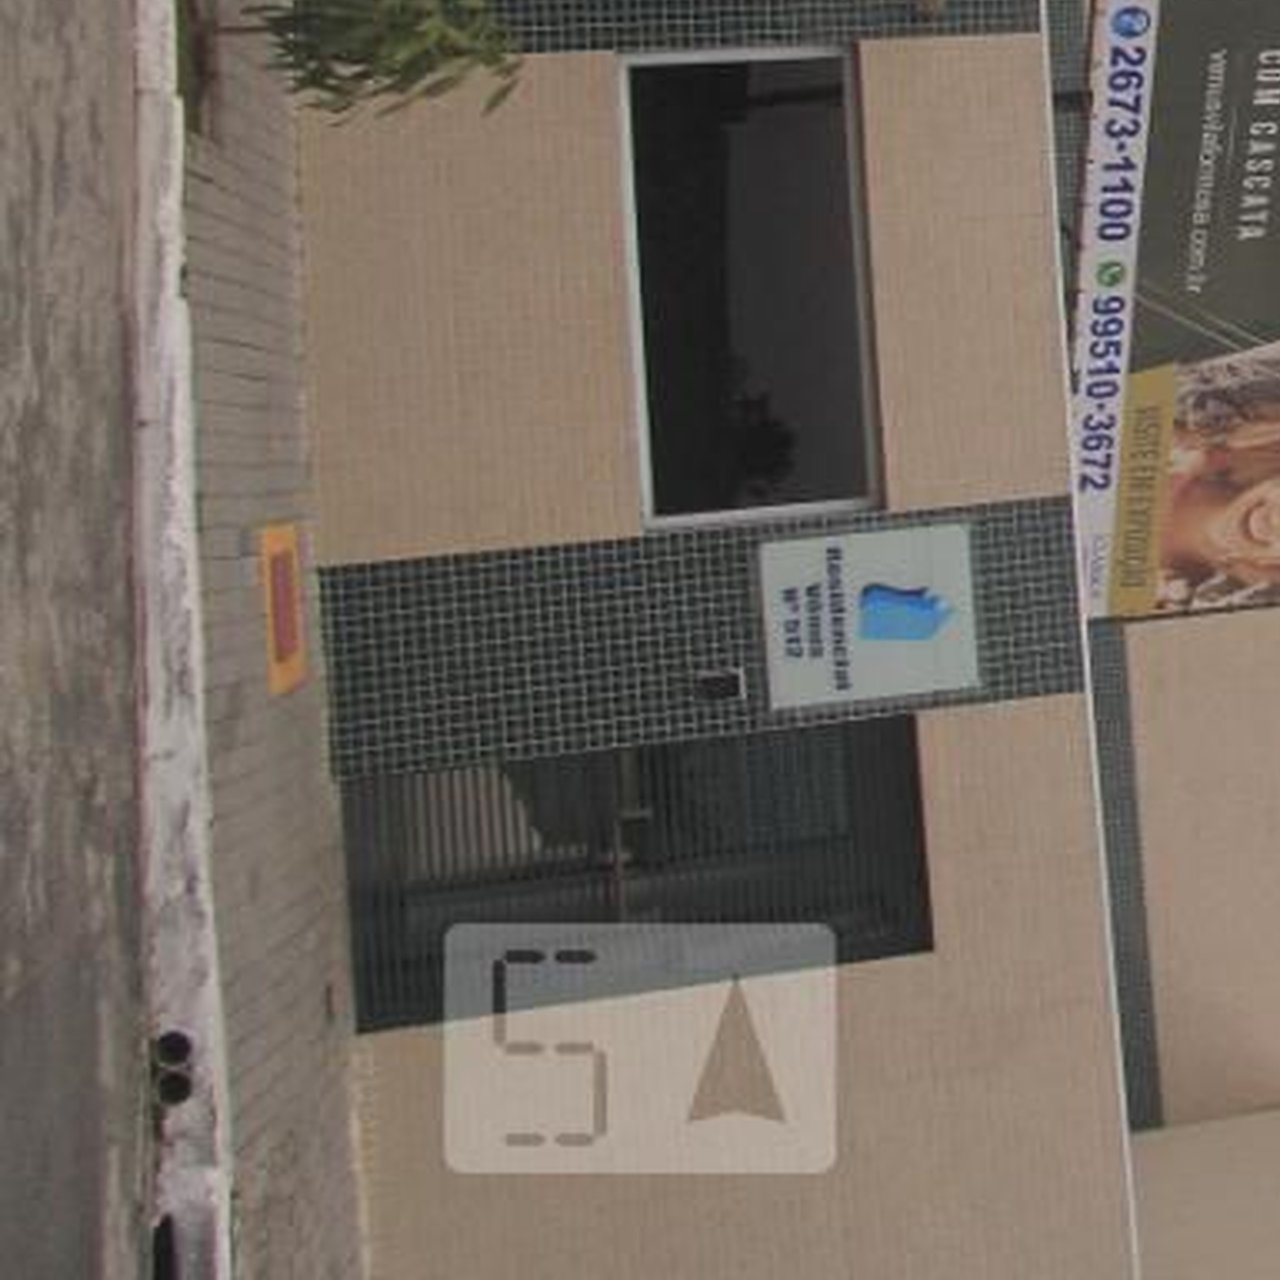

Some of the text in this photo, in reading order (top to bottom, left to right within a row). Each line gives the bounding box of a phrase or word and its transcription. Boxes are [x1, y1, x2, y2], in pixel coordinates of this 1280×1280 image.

[1096, 47, 1147, 242] 2673-1100
[1238, 120, 1279, 241] CASCATA
[1079, 295, 1125, 492] 99510-3672
